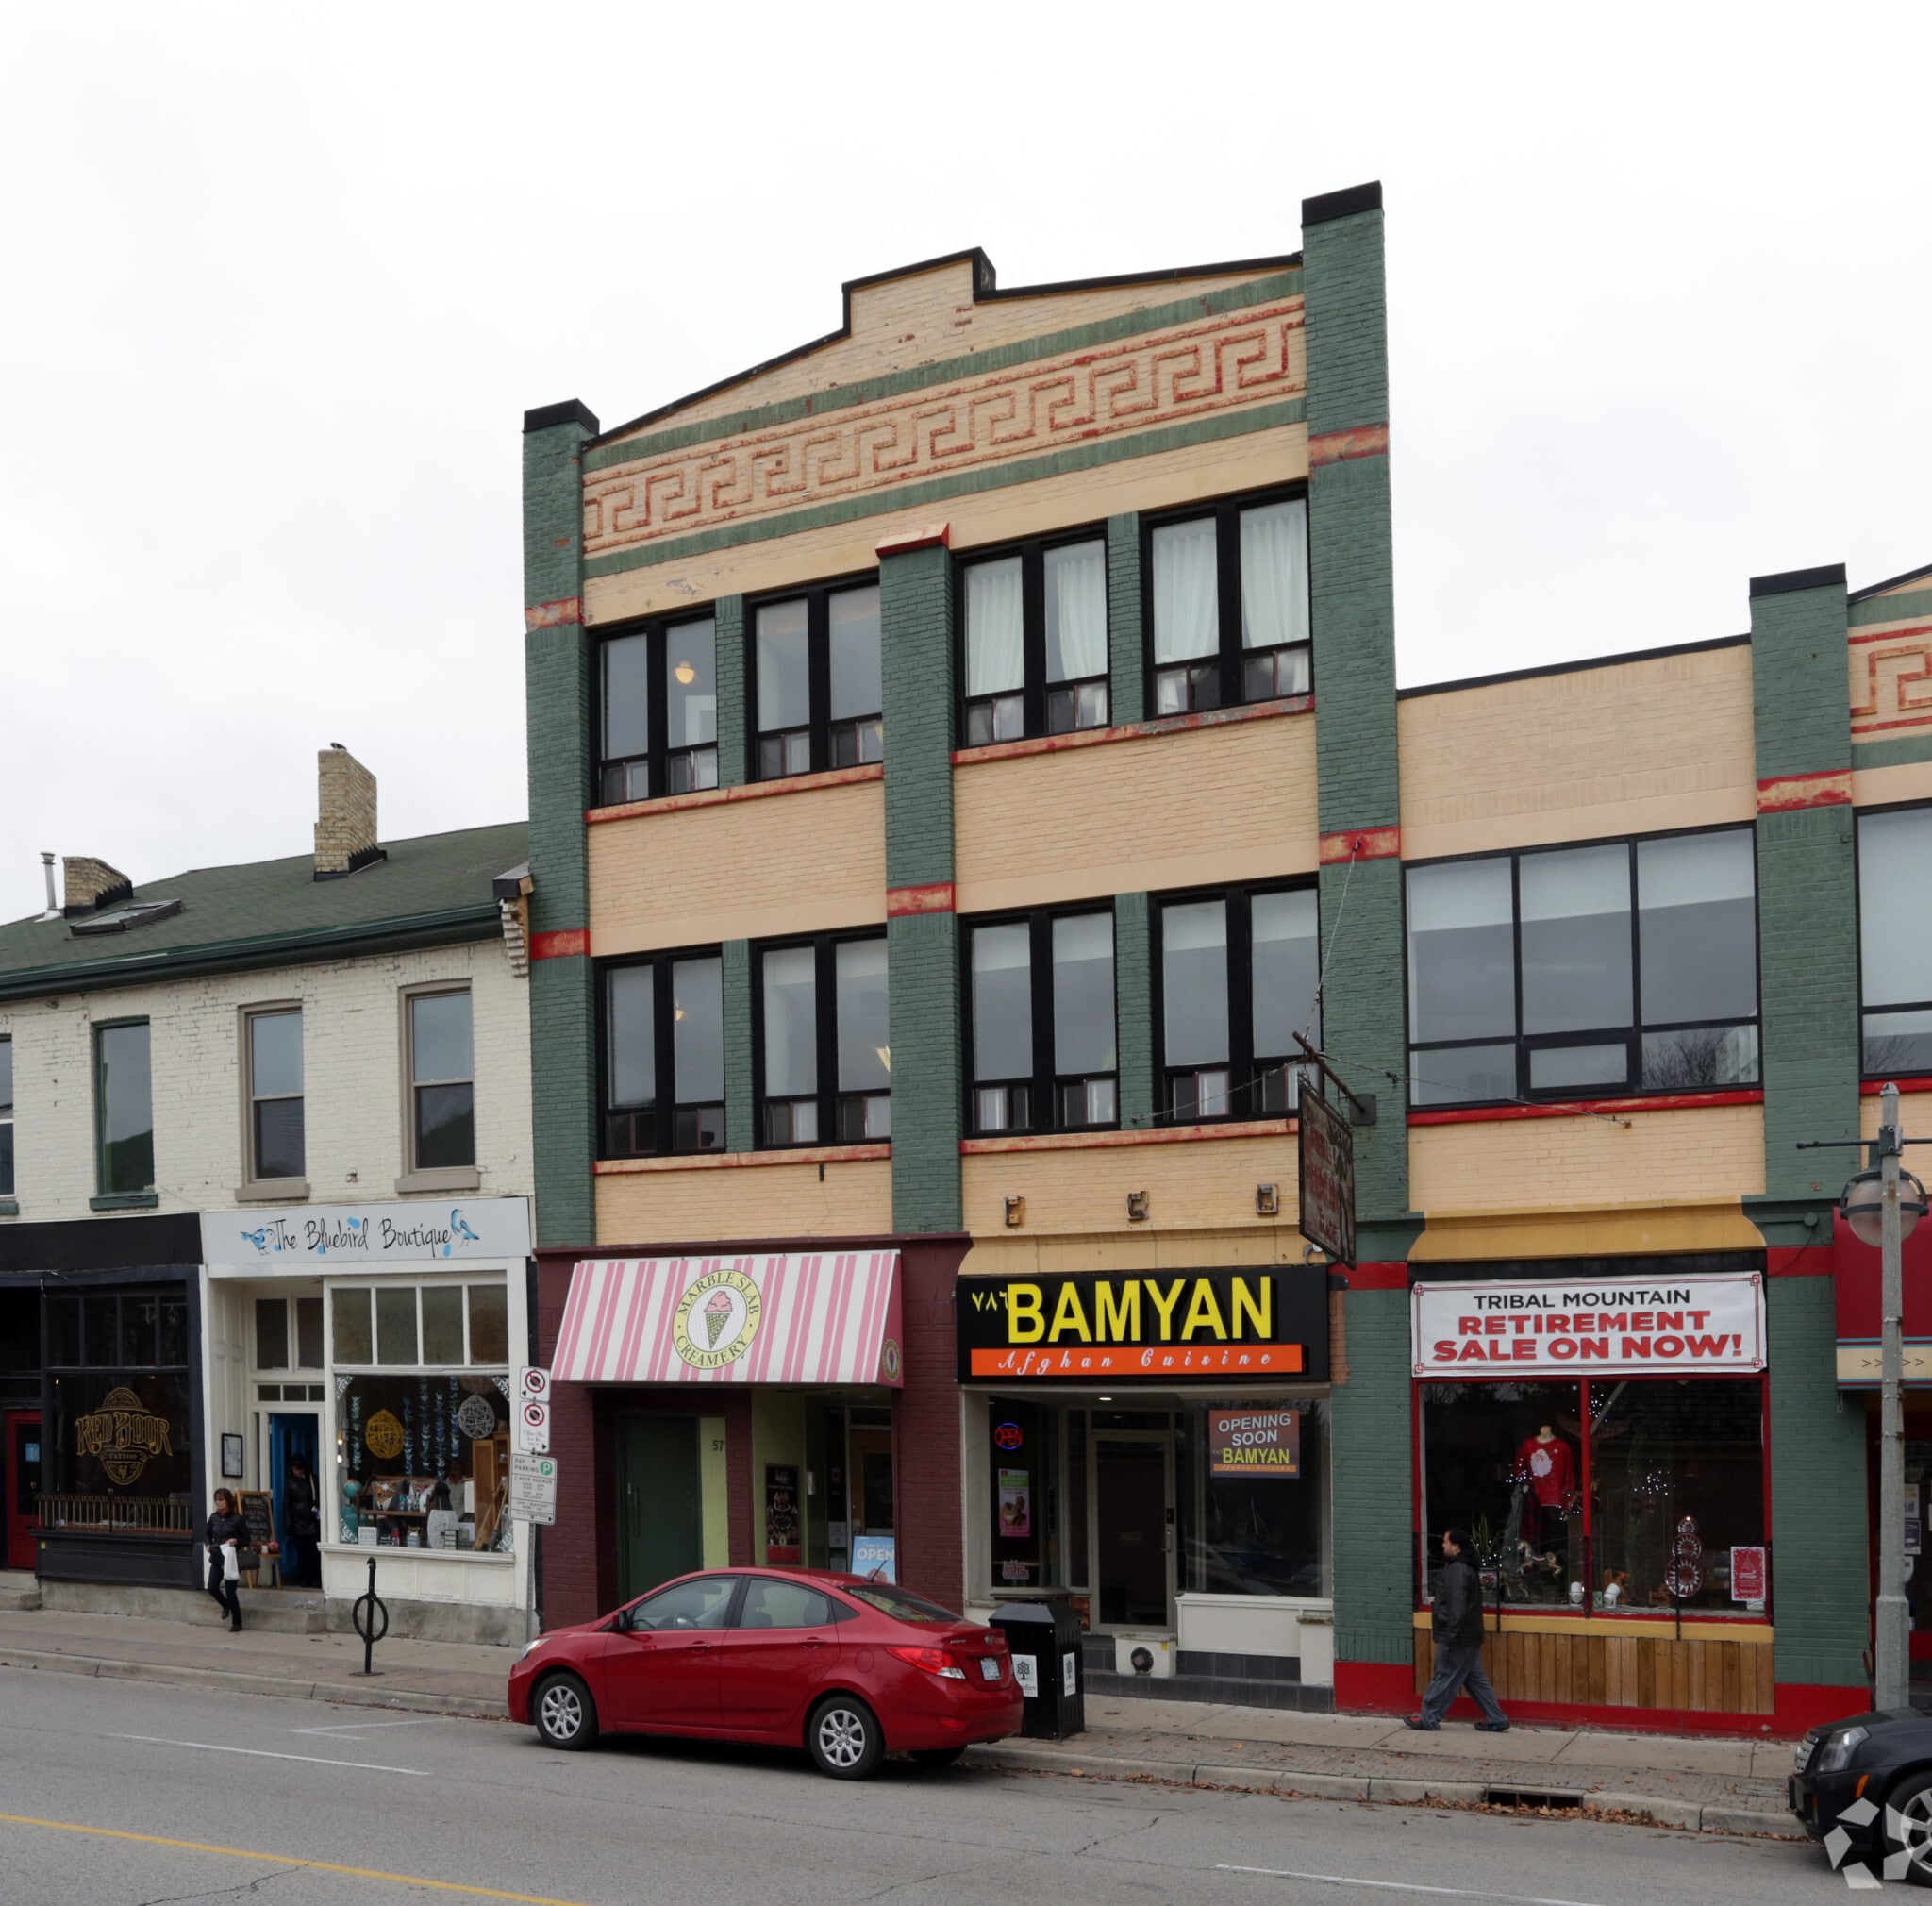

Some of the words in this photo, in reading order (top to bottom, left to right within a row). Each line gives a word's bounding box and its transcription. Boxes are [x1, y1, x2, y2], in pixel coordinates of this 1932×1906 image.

[267, 1218, 297, 1251] The
[304, 1217, 369, 1254] Bluebird
[379, 1217, 452, 1258] Boutique
[677, 1271, 736, 1316] MARBLE
[736, 1276, 759, 1315] SLAB
[1474, 1294, 1555, 1310] TRIBAL
[1562, 1289, 1690, 1308] MOUNTAIN
[1008, 1276, 1272, 1343] BAMYAN
[1458, 1310, 1711, 1336] RETIREMENT
[676, 1335, 748, 1367] CREAMERY
[998, 1351, 1113, 1375] Afghan
[1141, 1347, 1272, 1368] Cuisine
[1433, 1338, 1538, 1363] SALE
[1547, 1336, 1609, 1360] ON
[1622, 1334, 1742, 1359] NOW!
[75, 1413, 114, 1455] RED
[1218, 1413, 1291, 1432] OPENING
[994, 1427, 1024, 1446] OPEN
[1231, 1430, 1278, 1446] SOON
[514, 1464, 539, 1473] PARKING
[1223, 1447, 1291, 1464] BAMYAN
[857, 1547, 894, 1561] OPEN
